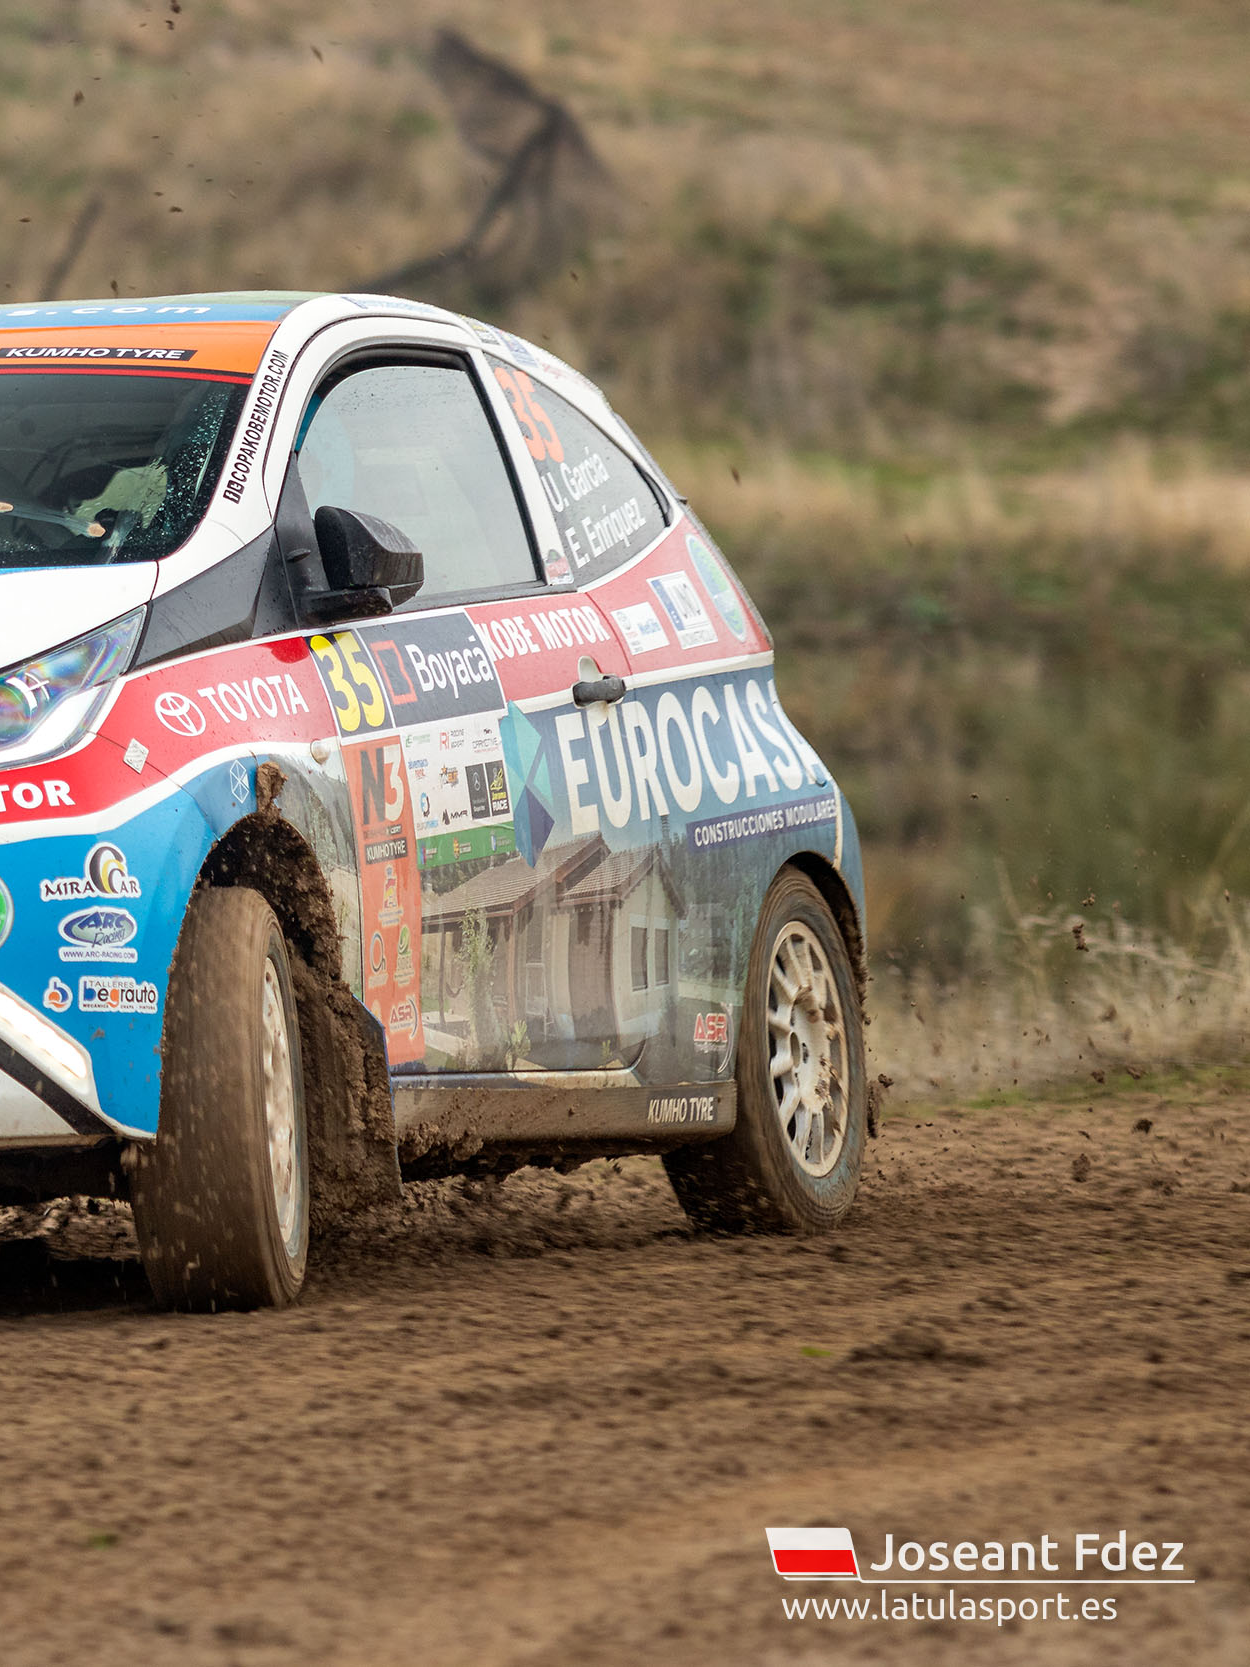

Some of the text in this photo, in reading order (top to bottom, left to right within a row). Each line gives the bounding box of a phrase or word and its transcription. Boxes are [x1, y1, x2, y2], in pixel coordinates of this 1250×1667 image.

[4, 347, 186, 360] KUMHO TYRE
[493, 367, 565, 464] 35
[540, 472, 570, 514] U.
[564, 524, 591, 569] E.
[475, 605, 611, 664] KOBE MOTOR
[309, 631, 386, 732] 35
[404, 635, 496, 700] Boyacá
[197, 673, 311, 724] TOYOTA
[360, 743, 405, 825] N3
[694, 798, 838, 847] CONSTRUCCIONES MODULARES
[366, 843, 390, 862] KUMHO
[390, 840, 406, 856] TYRE
[88, 980, 135, 988] TALLERES
[693, 1012, 728, 1042] ASR
[647, 1096, 715, 1124] KUMHO TYRE
